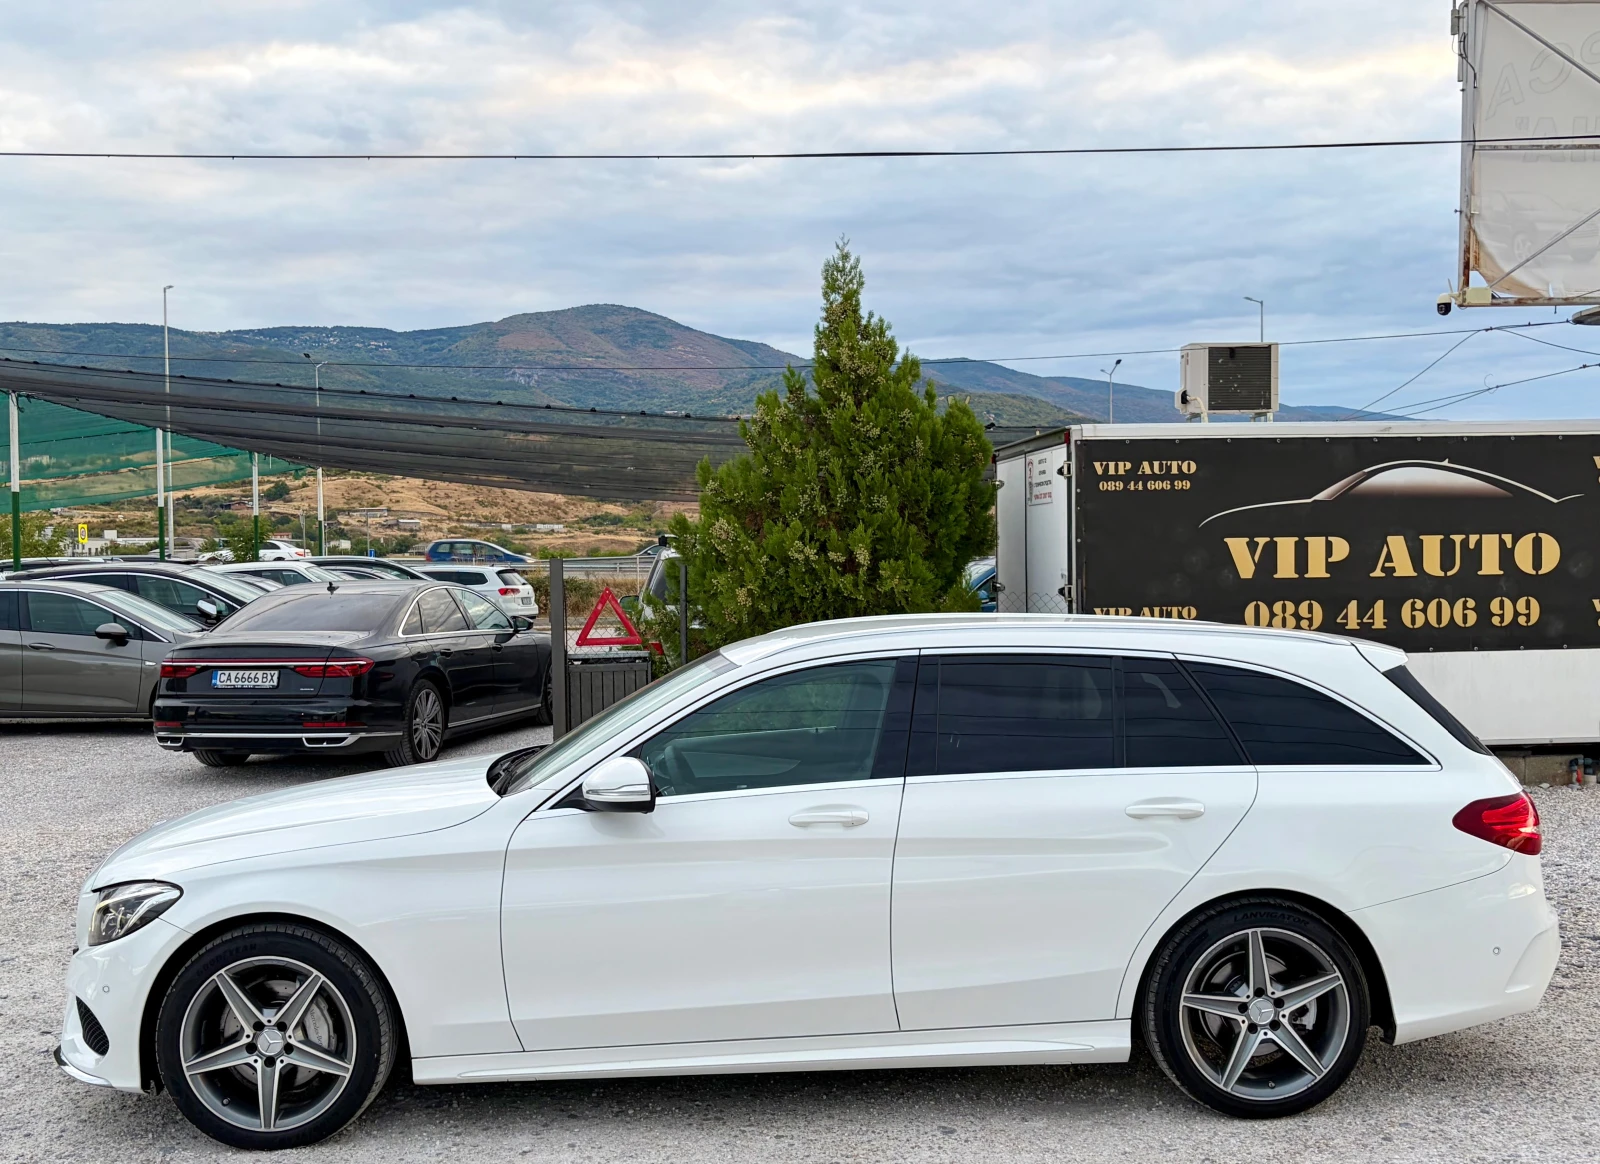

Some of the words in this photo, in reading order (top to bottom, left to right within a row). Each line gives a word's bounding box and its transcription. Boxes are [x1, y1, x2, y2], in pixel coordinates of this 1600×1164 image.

[1093, 461, 1132, 475] VIP
[1137, 460, 1197, 475] AUTO
[1099, 481, 1124, 491] 089
[1127, 481, 1143, 491] 44
[1146, 480, 1170, 491] 606
[1174, 480, 1191, 490] 99
[1224, 536, 1350, 579] VIP
[1370, 532, 1561, 577] AUTO
[1139, 606, 1197, 619] AUTO
[1244, 600, 1323, 630] 089
[1336, 599, 1388, 630] 44
[1401, 597, 1478, 629] 606
[1490, 596, 1541, 627] 99
[218, 672, 232, 684] CA
[234, 672, 260, 684] 6666
[261, 672, 276, 684] BX
[1233, 911, 1310, 926] LANVIGATOR
